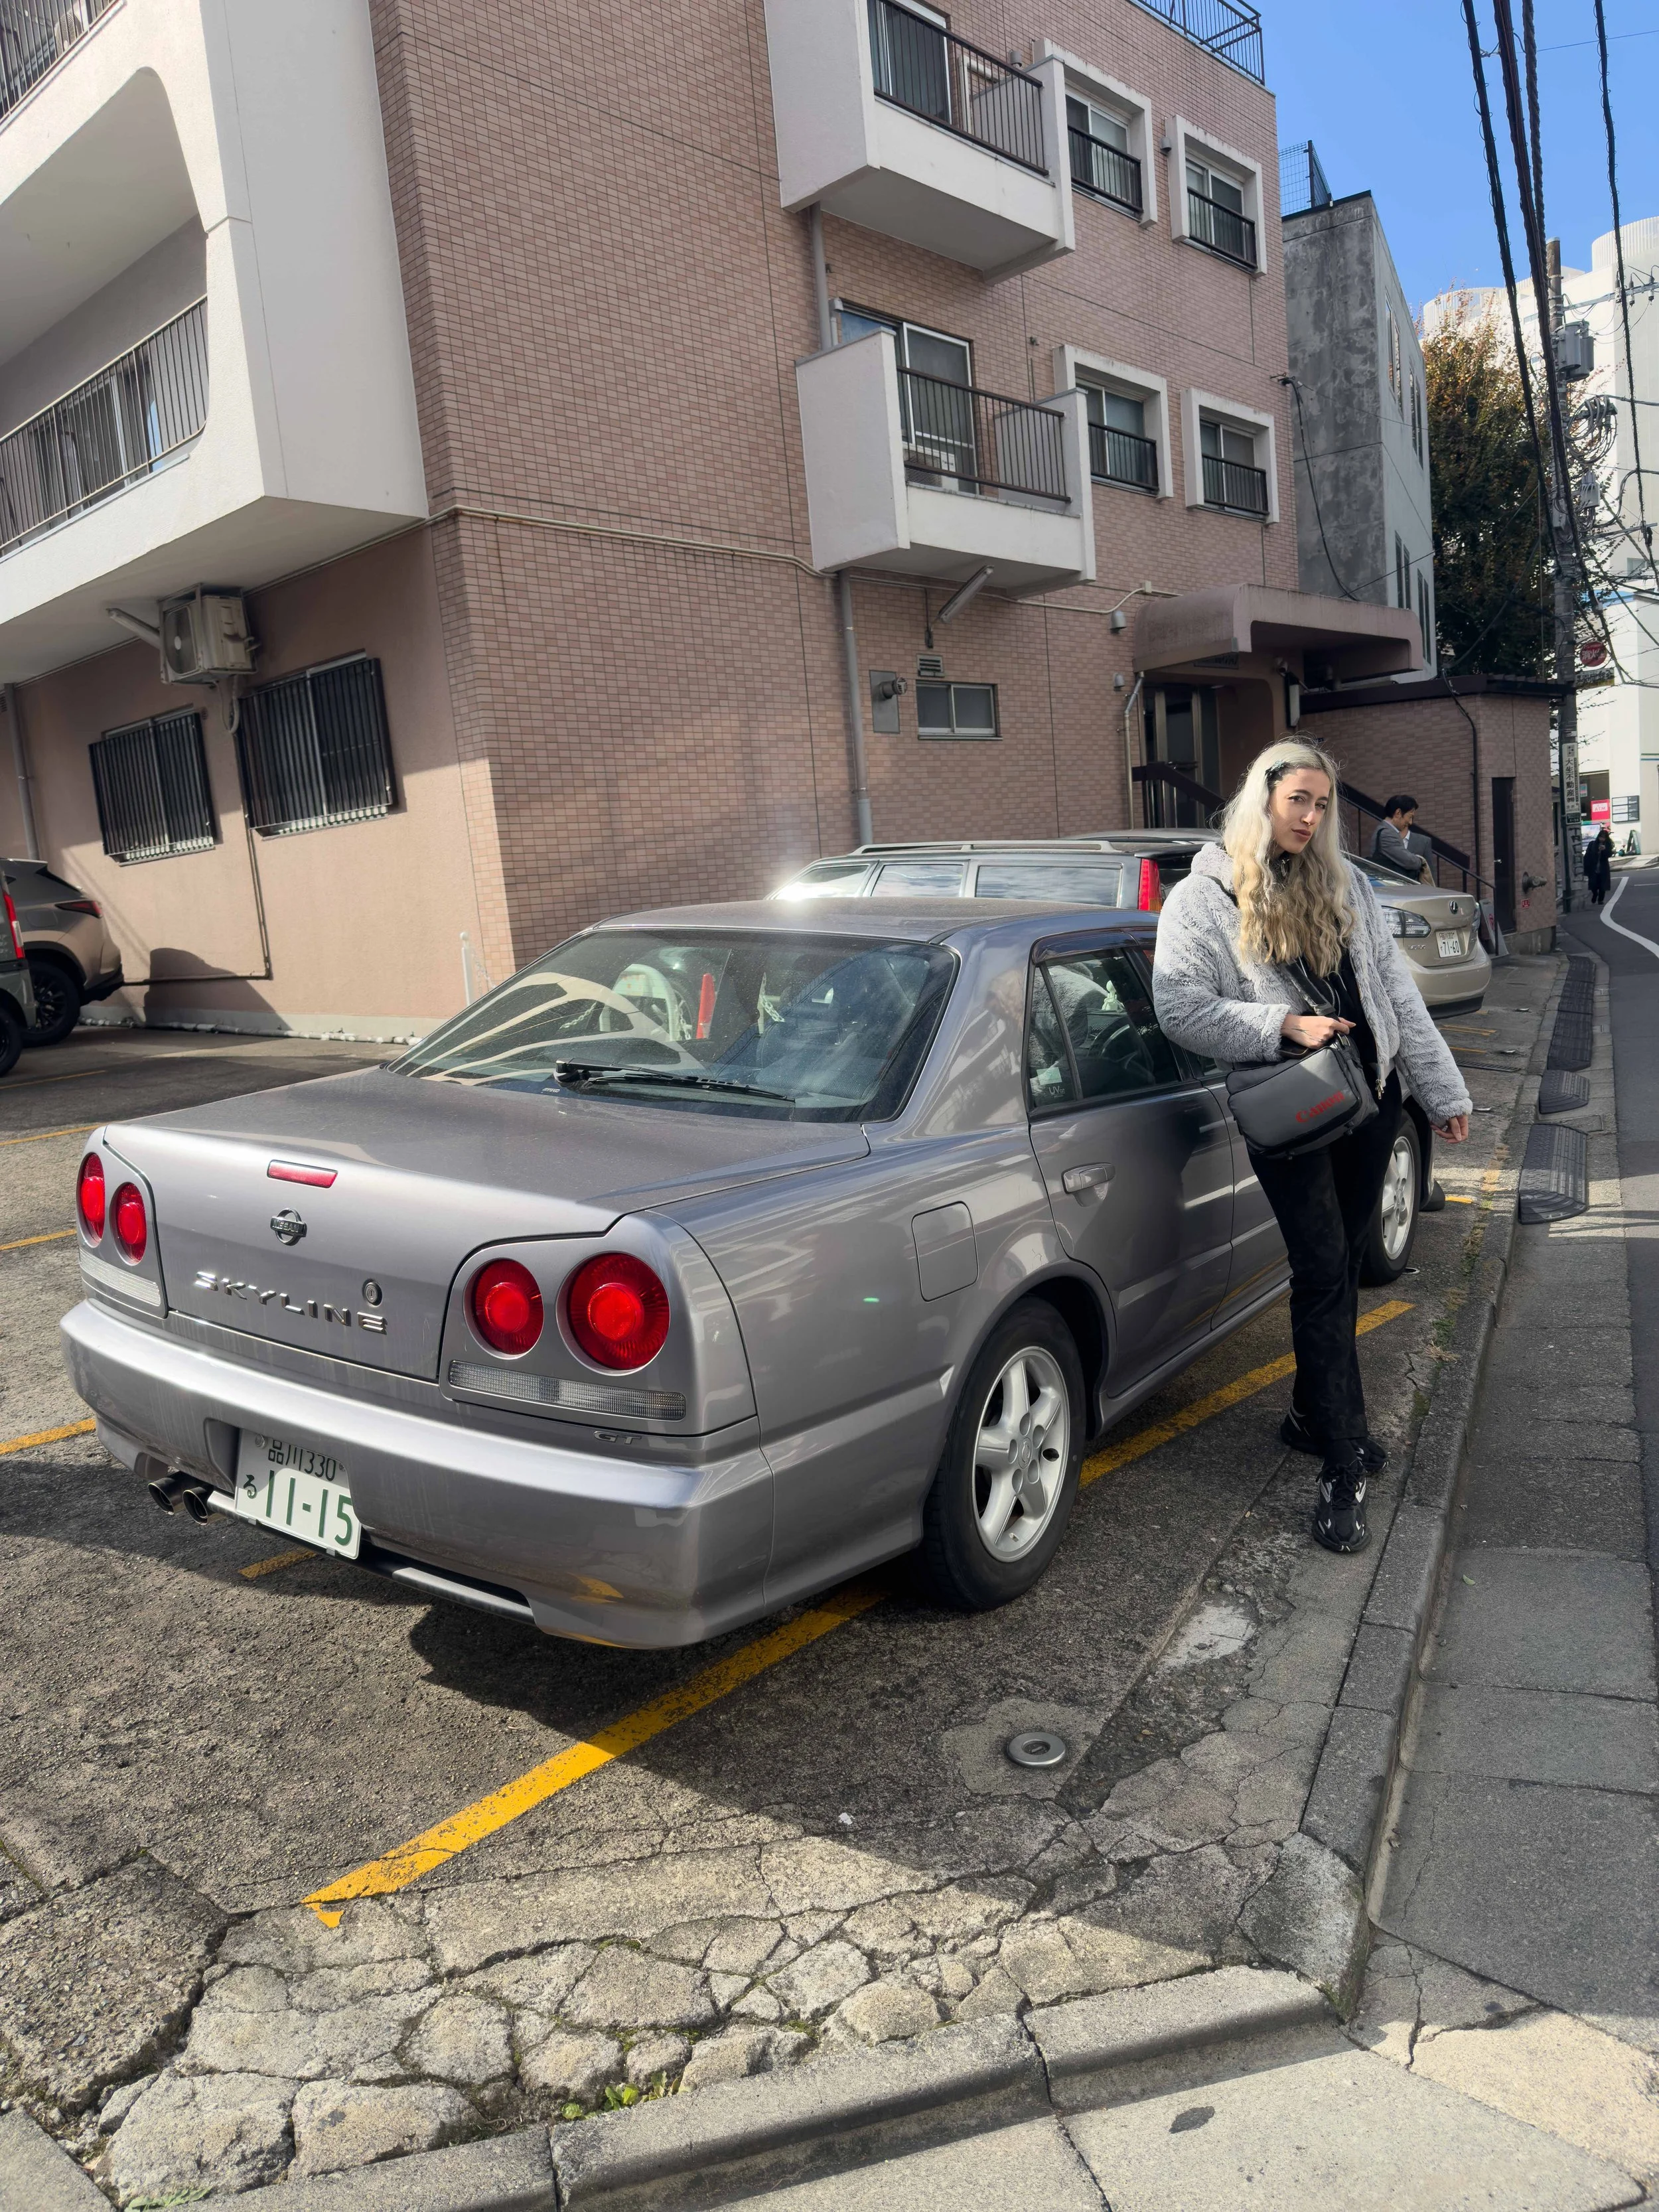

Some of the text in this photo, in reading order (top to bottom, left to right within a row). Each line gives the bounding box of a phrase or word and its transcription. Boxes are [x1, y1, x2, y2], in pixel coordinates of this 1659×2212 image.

[1443, 940, 1459, 955] 71-60
[1295, 1090, 1345, 1123] Canon
[194, 1271, 388, 1335] SKYLINE
[593, 1431, 642, 1445] GT
[243, 1470, 353, 1546] る 11-15
